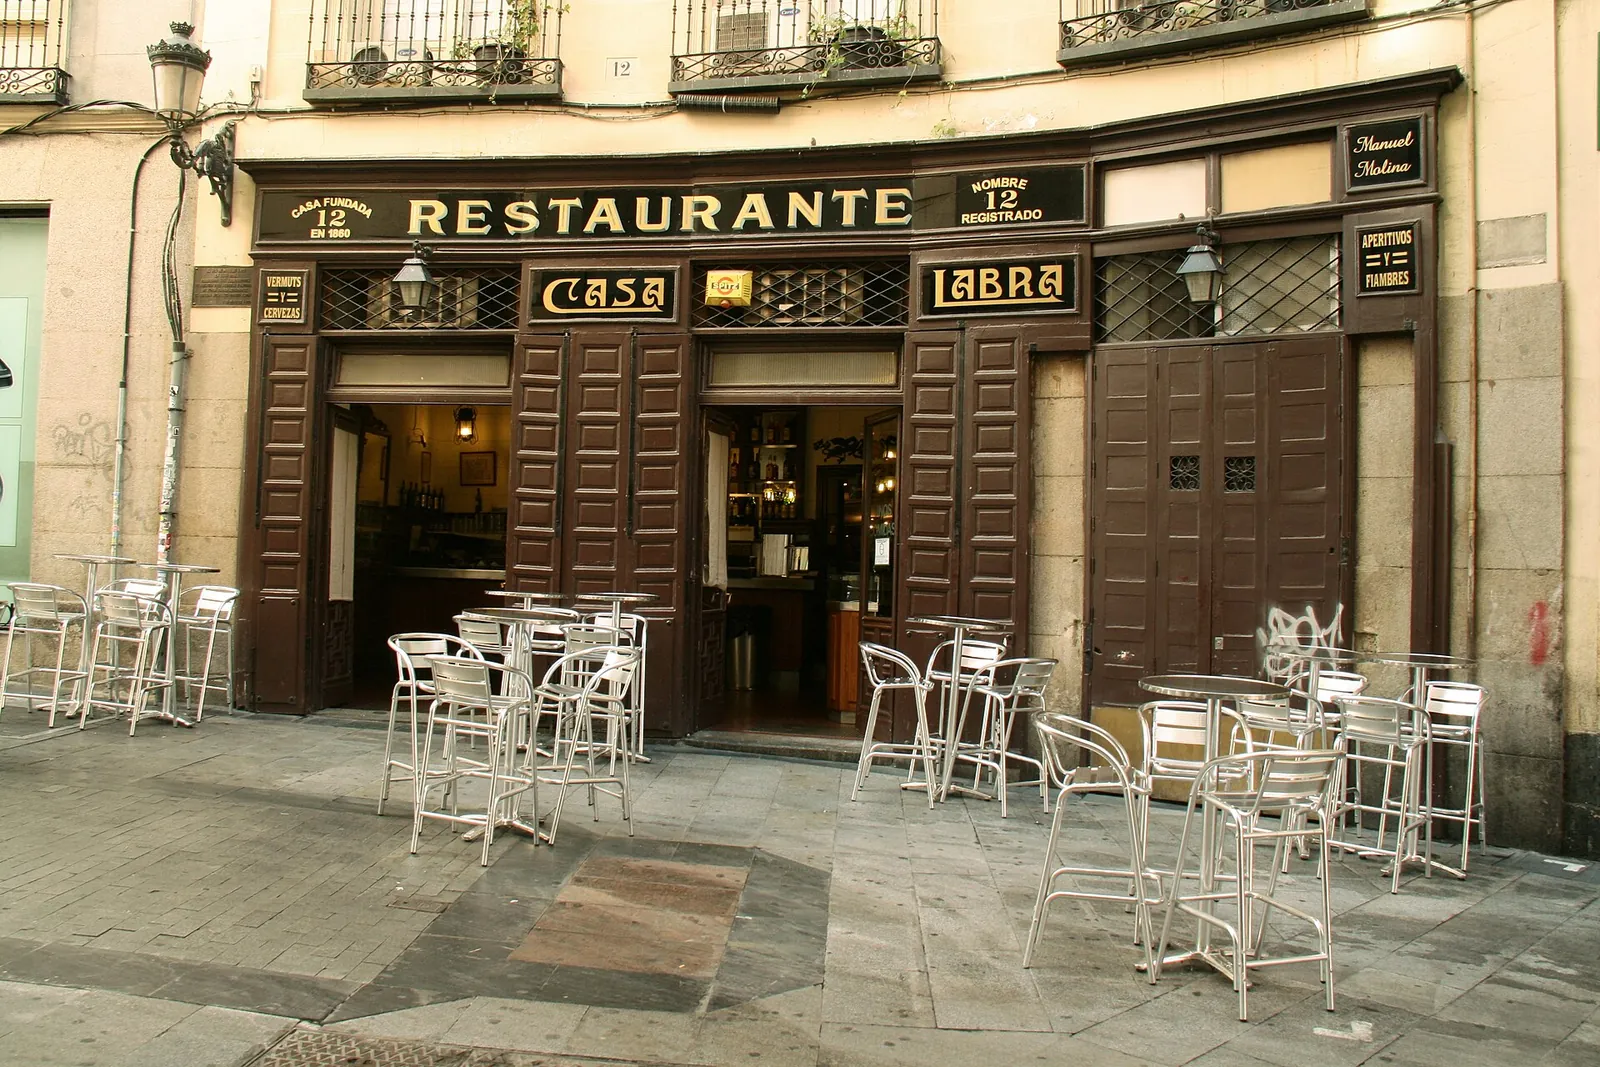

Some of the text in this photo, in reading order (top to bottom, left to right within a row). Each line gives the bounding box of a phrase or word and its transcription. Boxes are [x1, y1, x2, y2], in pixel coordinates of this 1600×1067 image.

[614, 61, 630, 76] 12
[1353, 131, 1414, 153] Manuel
[1354, 159, 1412, 178] Molina
[972, 177, 1028, 194] NOMBRE
[291, 197, 373, 219] CASA FUNDADA
[986, 190, 1018, 210] 12
[317, 209, 346, 227] 12
[407, 187, 913, 236] RESTAURANTE
[961, 208, 1043, 224] REGISTRADO
[310, 228, 351, 238] EN 1860
[1362, 230, 1412, 248] APERITIVOS
[1383, 252, 1390, 267] Y
[266, 276, 302, 288] VERMUTS
[932, 264, 1064, 308] LABRA
[1365, 270, 1409, 288] FIAMBRES
[280, 291, 286, 303] Y
[542, 277, 665, 314] CASA
[263, 307, 301, 319] CERVEZAS
